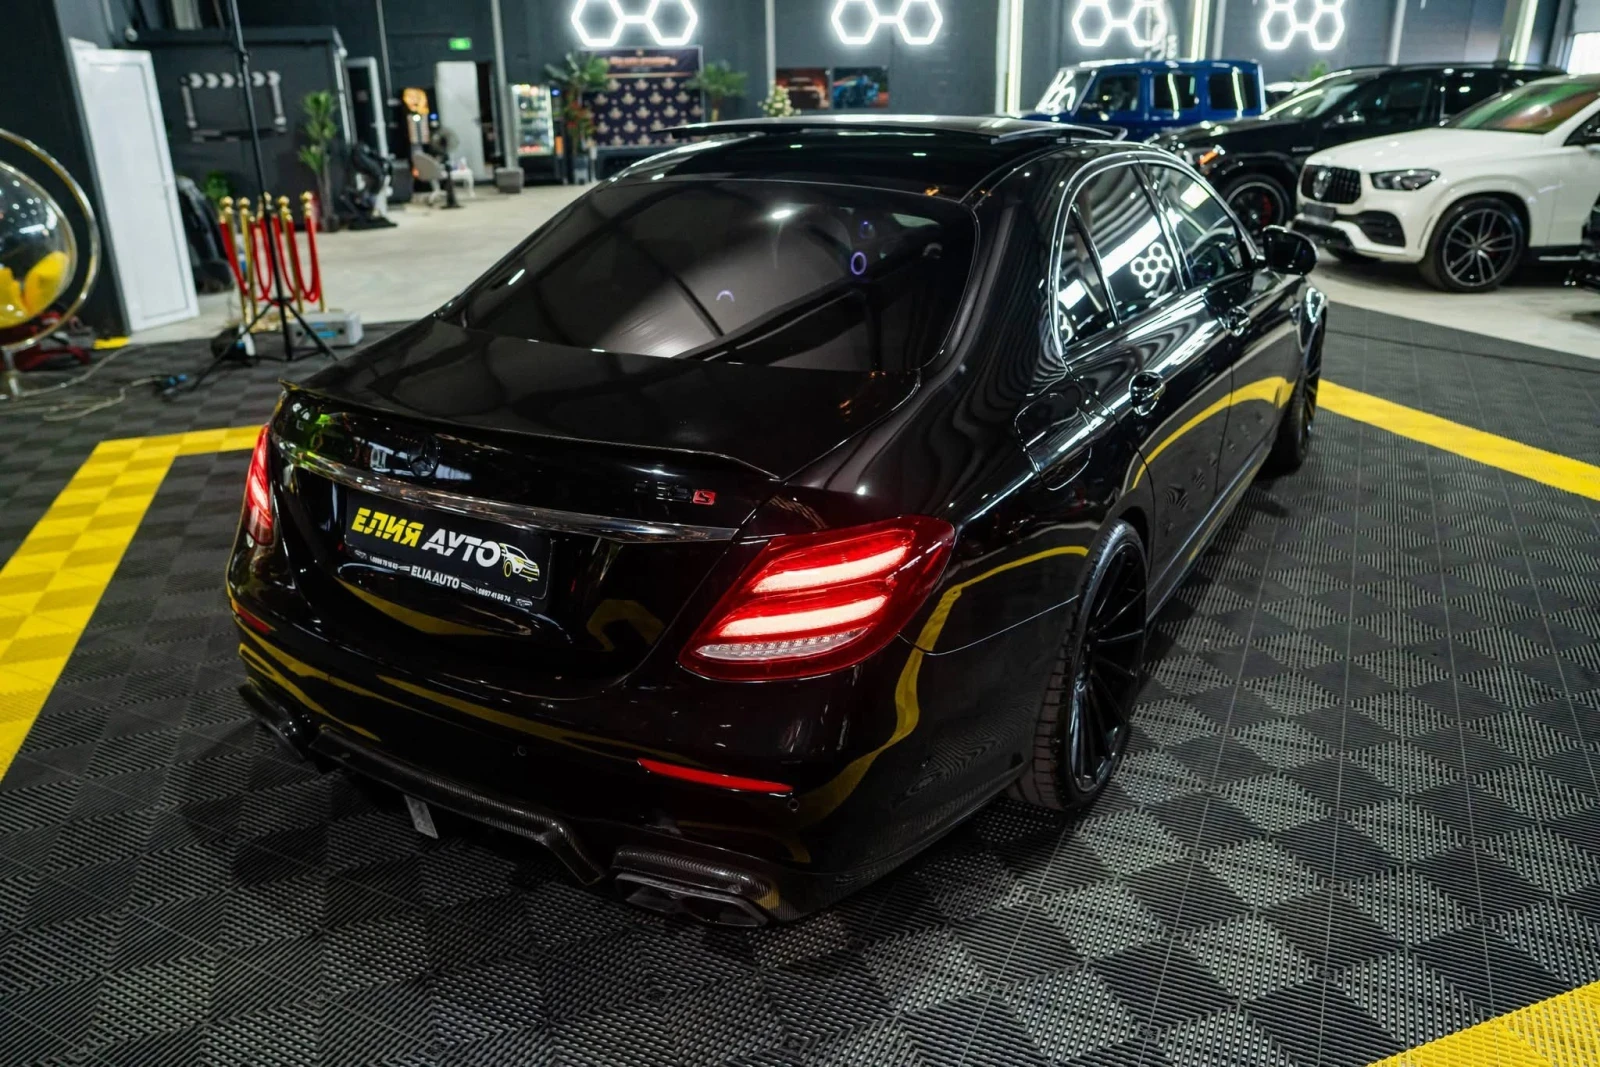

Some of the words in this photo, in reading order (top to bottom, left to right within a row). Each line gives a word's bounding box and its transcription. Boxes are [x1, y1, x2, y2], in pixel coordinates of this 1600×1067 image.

[351, 507, 424, 548] ЕЛИЯ
[421, 528, 501, 568] АУТО
[410, 565, 432, 582] ELIA
[432, 571, 460, 589] AUTO
